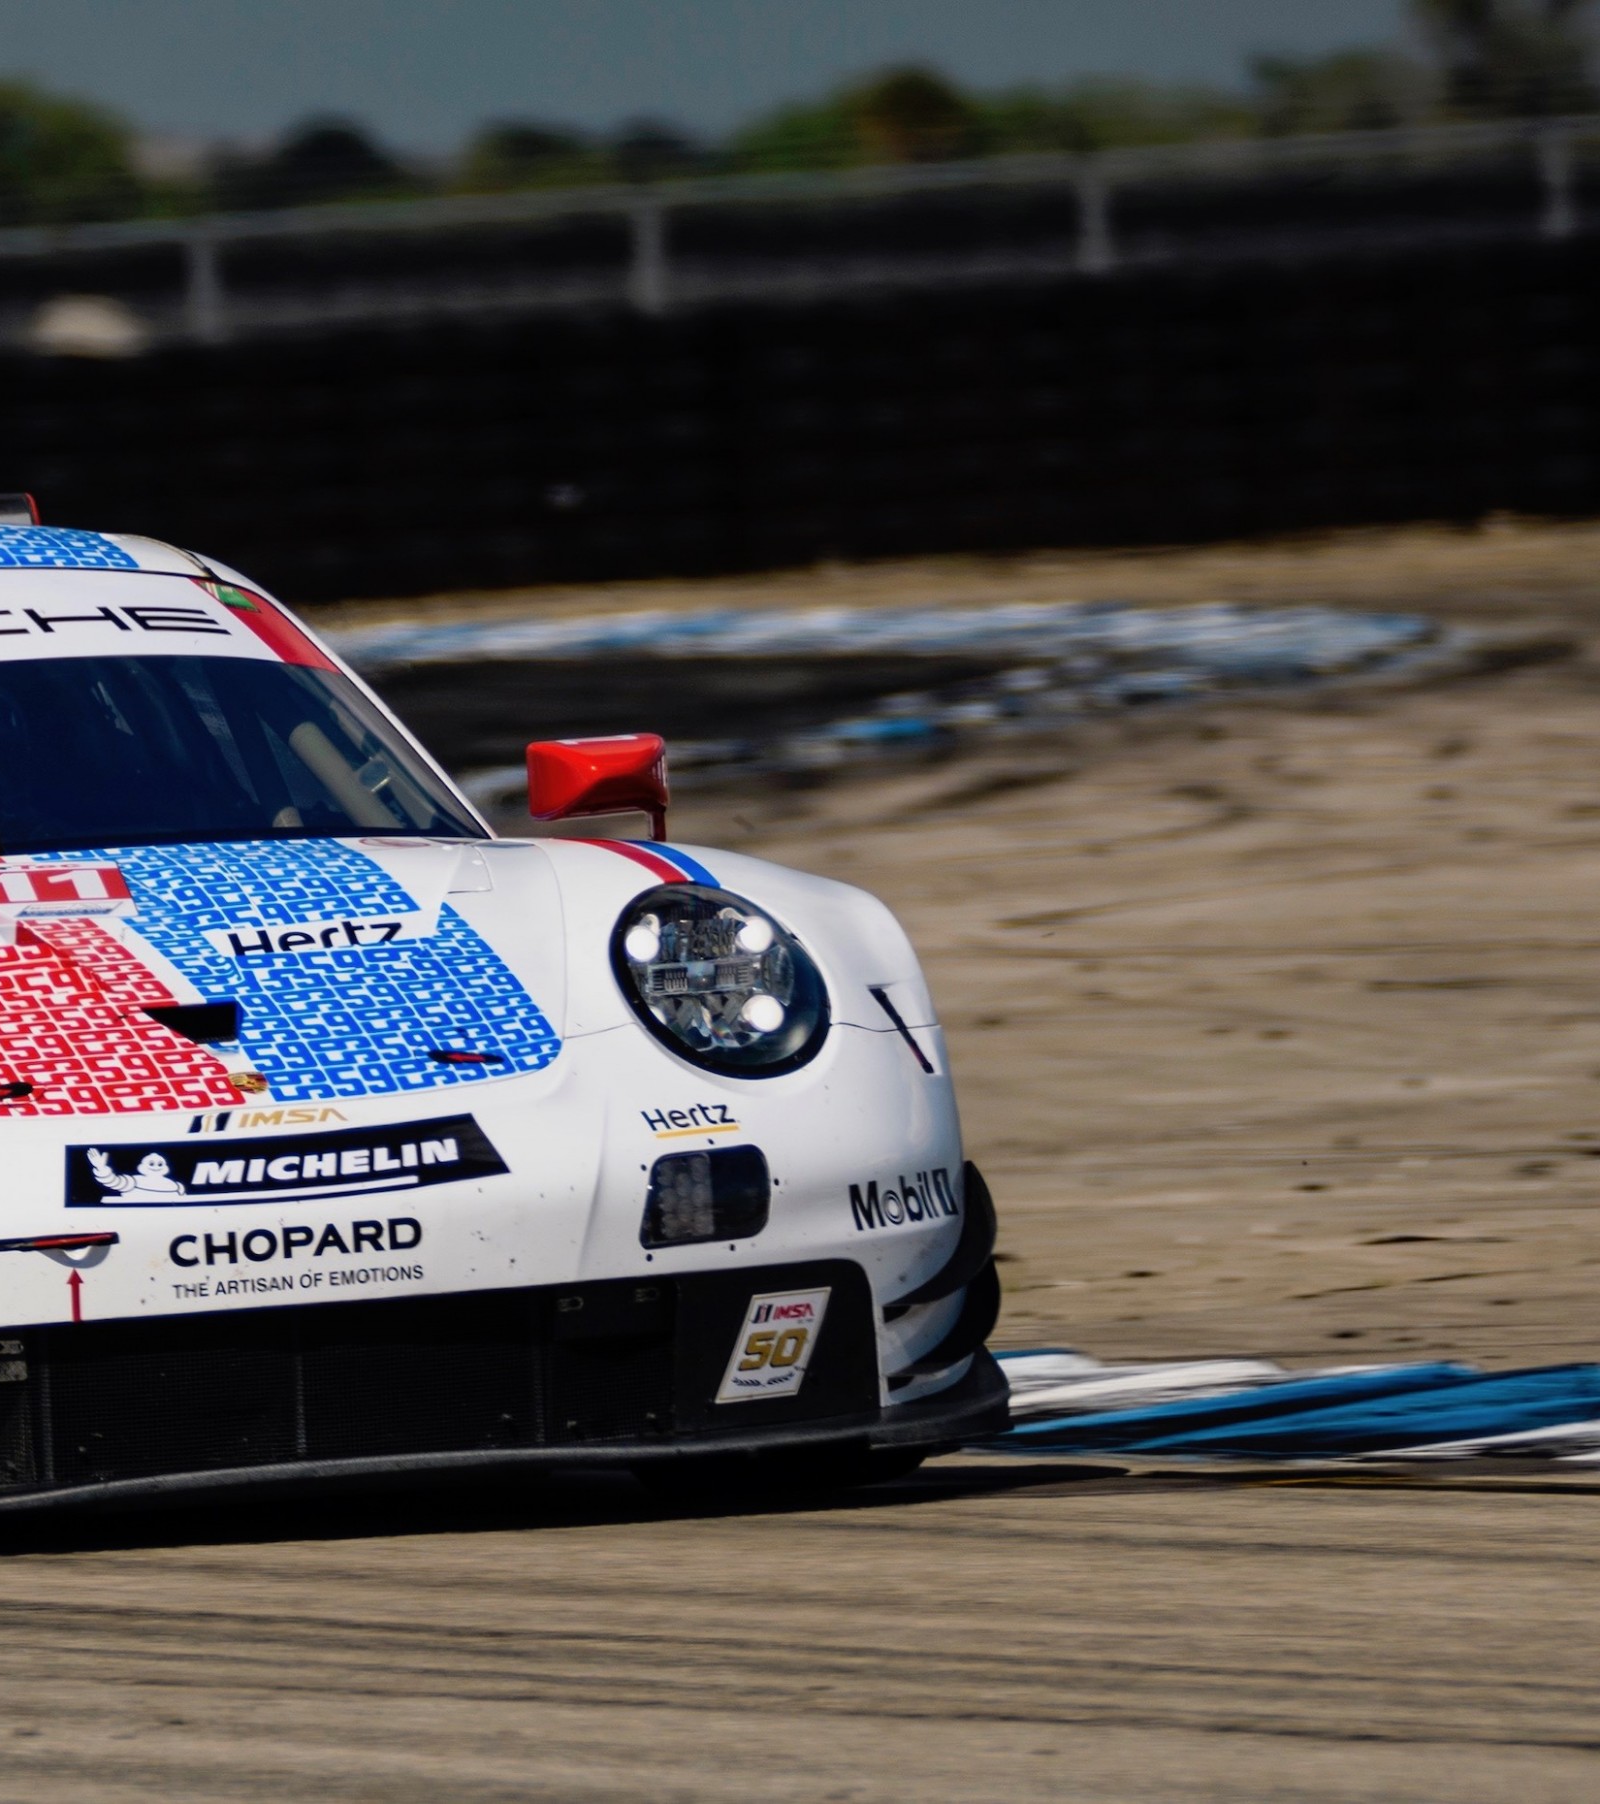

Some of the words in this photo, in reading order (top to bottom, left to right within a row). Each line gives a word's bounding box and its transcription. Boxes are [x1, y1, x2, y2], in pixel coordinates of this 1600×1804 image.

[227, 920, 403, 956] Hertz
[238, 1108, 348, 1129] IMSA
[640, 1103, 734, 1132] Hertz
[191, 1138, 460, 1185] MICHELIN
[849, 1171, 939, 1231] Mobil
[169, 1217, 422, 1267] CHOPARD
[173, 1281, 209, 1299] THE
[215, 1276, 293, 1297] ARTISAN
[300, 1272, 323, 1289] OF
[330, 1265, 424, 1286] EMOTIONS
[773, 1303, 814, 1320] IMSA
[738, 1328, 807, 1372] 50
